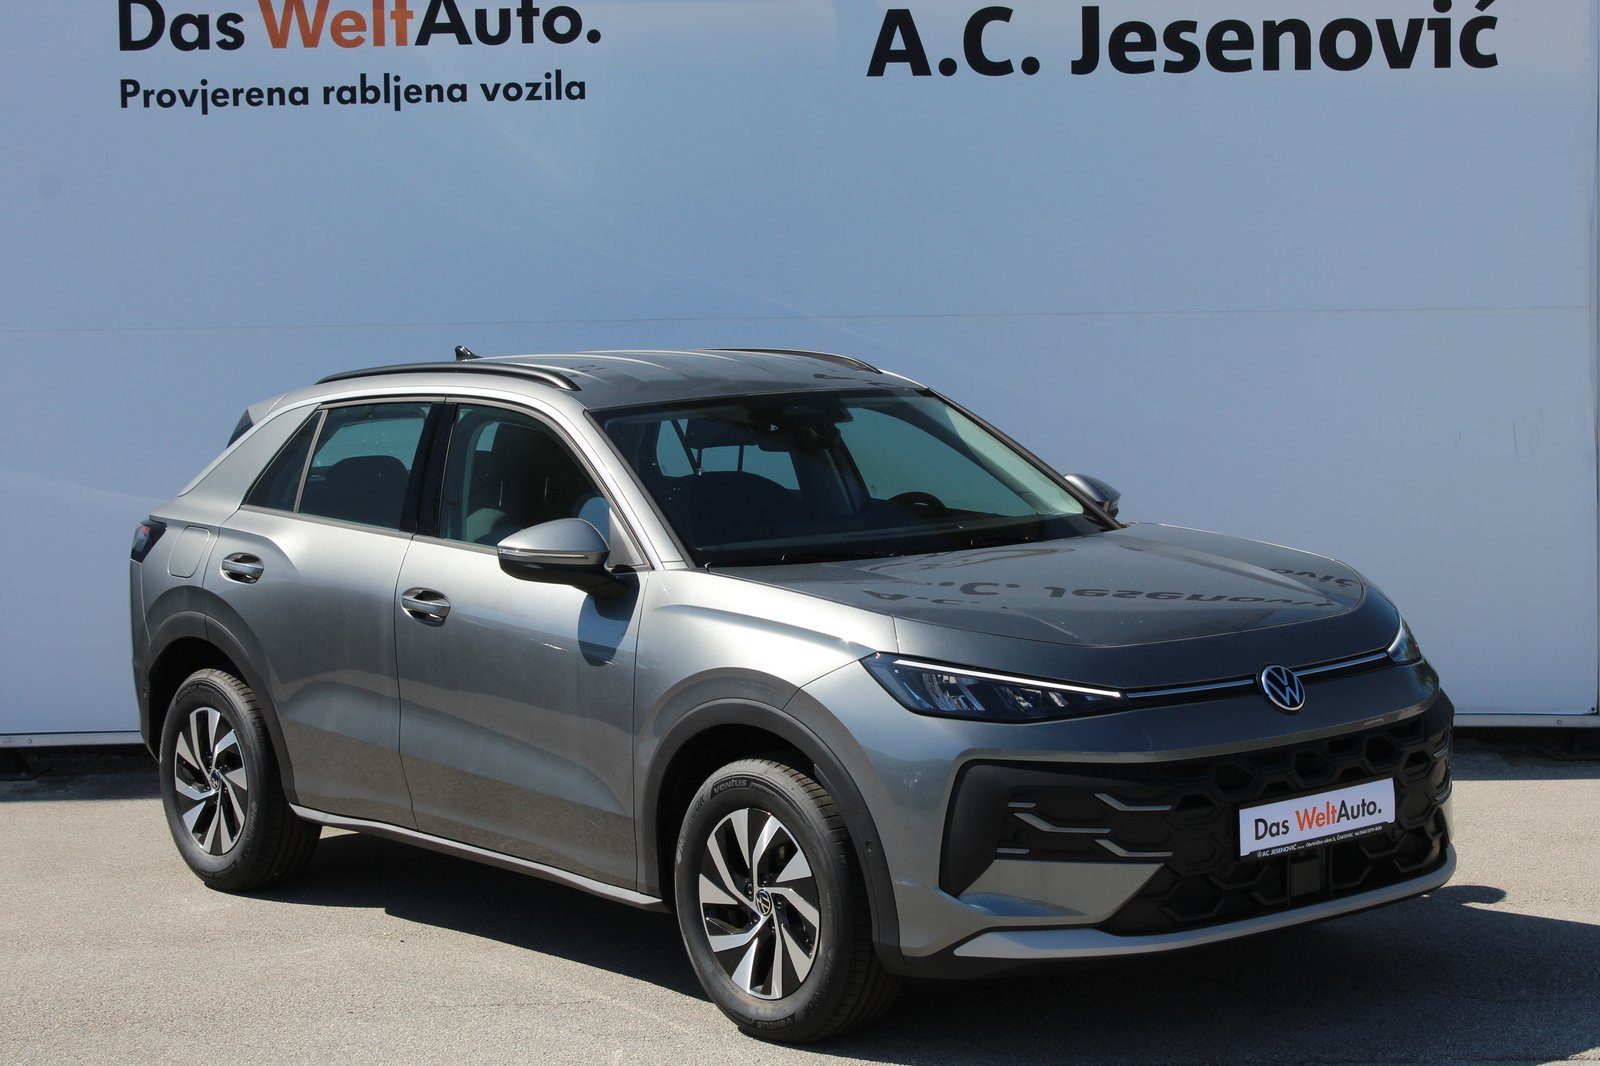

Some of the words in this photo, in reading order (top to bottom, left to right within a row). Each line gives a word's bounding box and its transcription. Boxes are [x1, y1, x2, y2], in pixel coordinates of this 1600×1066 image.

[118, 0, 245, 51] Das
[257, 0, 602, 49] WeltAuto.
[867, 7, 1040, 78] A.C.
[1071, 0, 1499, 75] Jesenović
[119, 79, 306, 115] Provjerena
[322, 73, 468, 111] rabljena
[480, 70, 586, 102] vozila
[1254, 818, 1290, 841] Das
[1295, 799, 1382, 831] WeltAuto.
